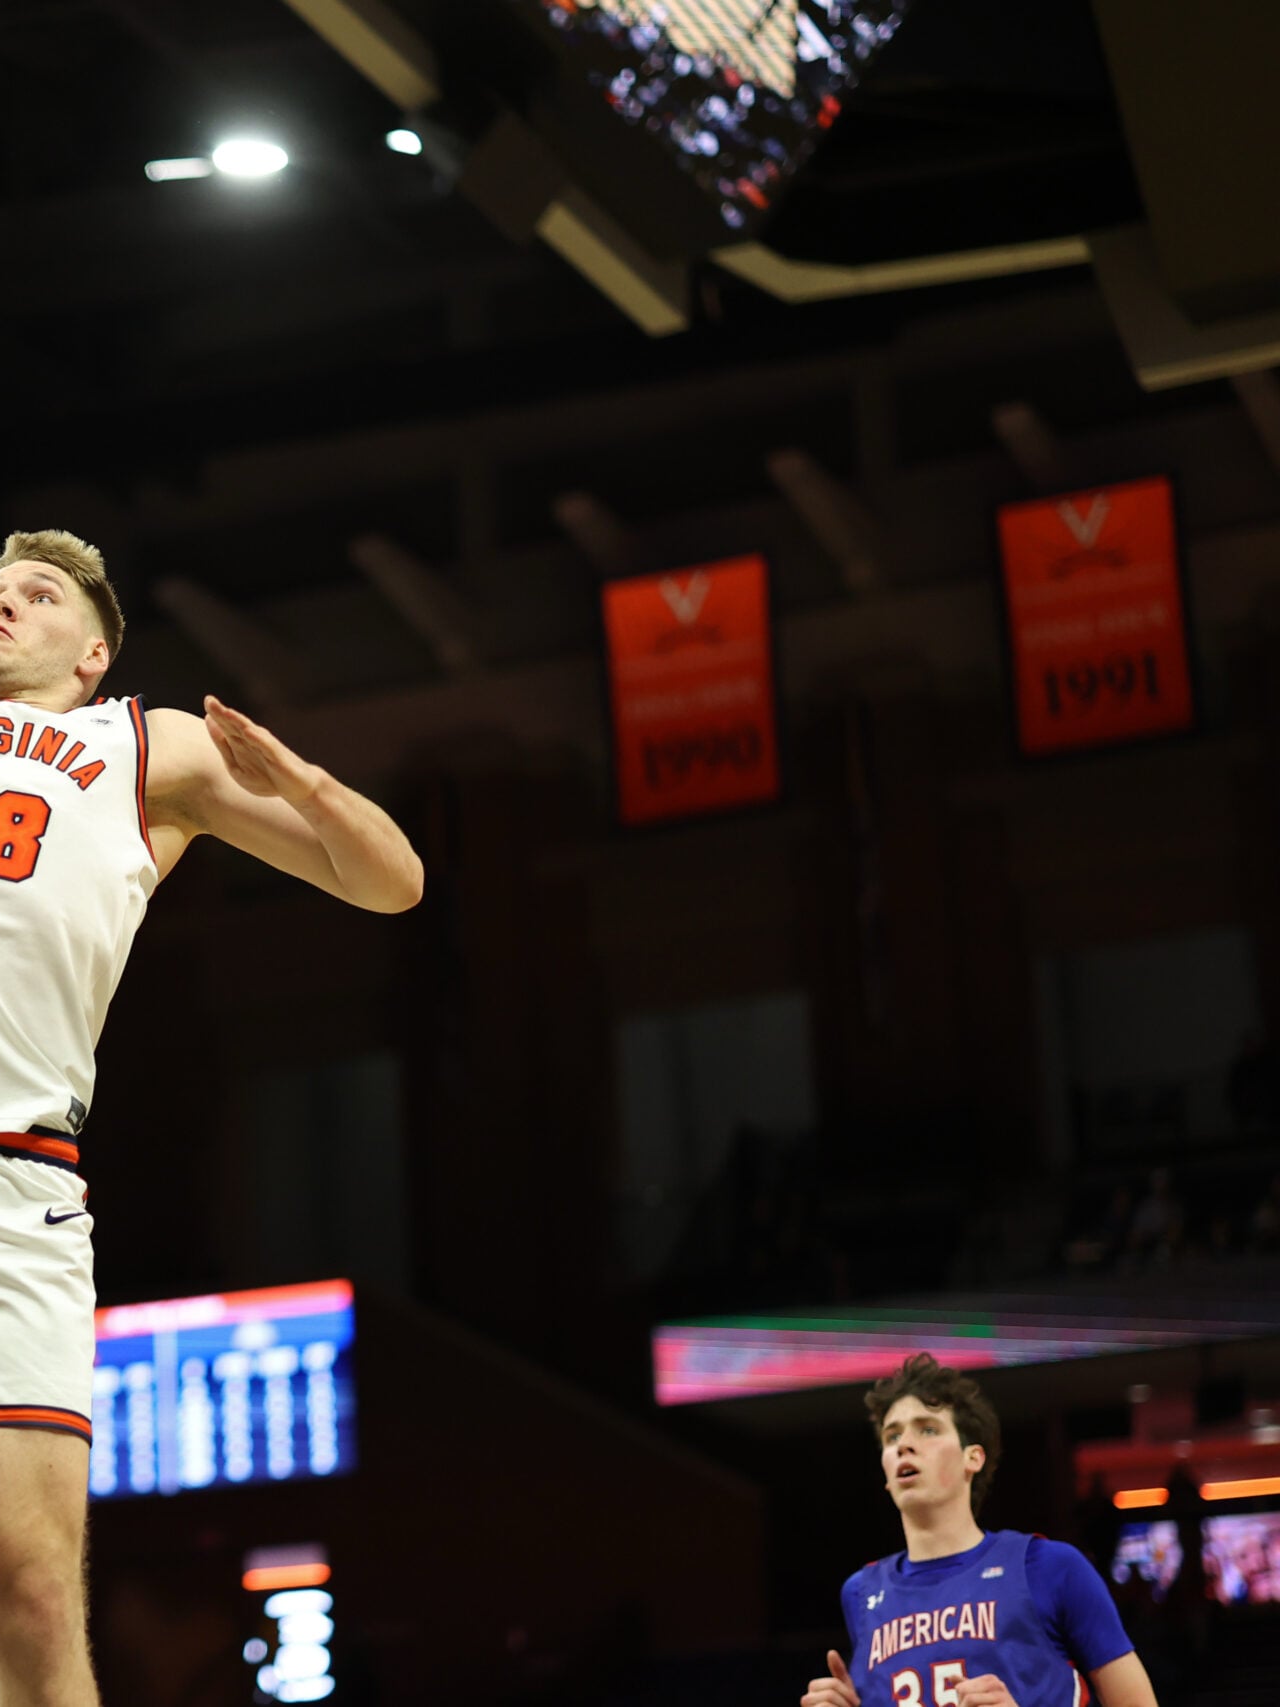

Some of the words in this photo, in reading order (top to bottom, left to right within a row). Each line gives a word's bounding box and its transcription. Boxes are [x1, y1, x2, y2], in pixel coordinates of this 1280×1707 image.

[1044, 652, 1159, 716] 1991
[868, 1601, 996, 1671] AMERICAN
[891, 1658, 968, 1707] 35
